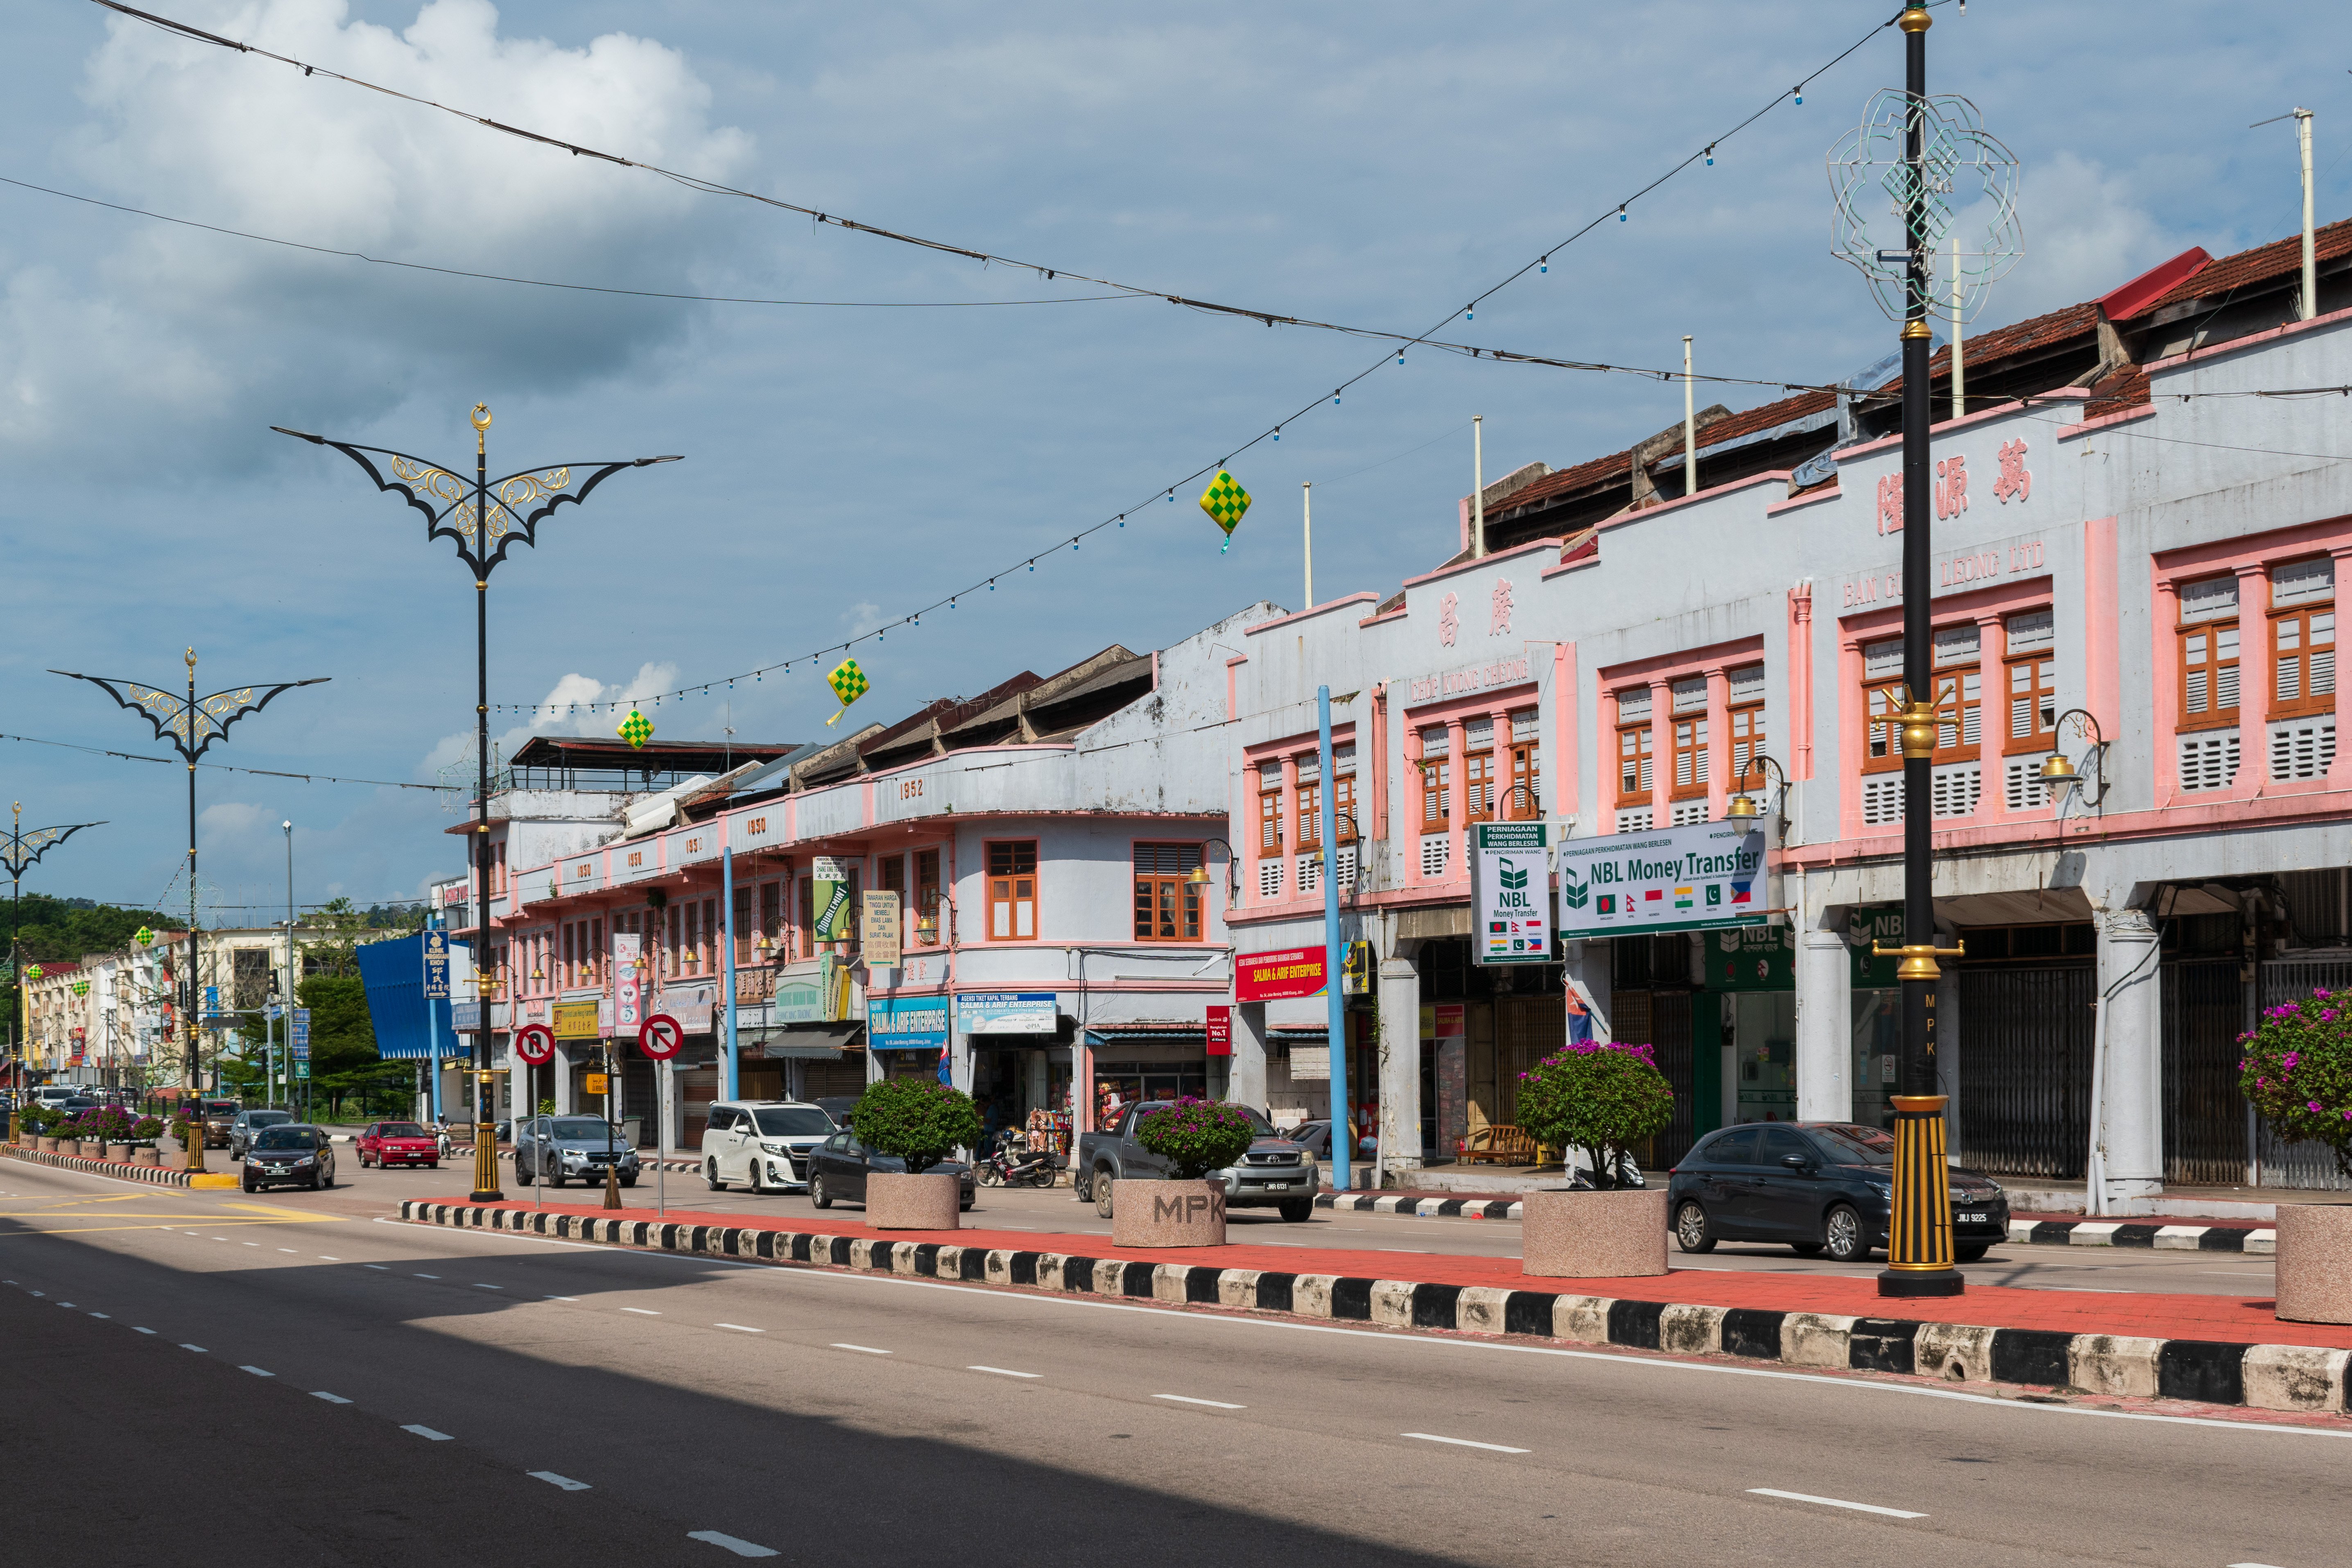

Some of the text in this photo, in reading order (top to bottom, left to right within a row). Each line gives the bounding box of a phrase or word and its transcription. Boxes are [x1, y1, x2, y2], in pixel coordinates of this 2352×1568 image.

[1843, 541, 2044, 608] BAN GU LEONG LTD
[1412, 657, 1528, 702] CHOP KWONG CHEONG
[900, 779, 923, 800] 1952
[748, 817, 766, 836] 1950
[686, 837, 703, 853] 1950
[1566, 848, 1594, 857] PERNIAGAAN
[1595, 844, 1632, 853] PERKHIDMATAN
[1648, 839, 1671, 848] BERLESEN
[628, 851, 642, 867] 1950
[1591, 846, 1759, 885] NBL Money Transfer
[578, 863, 590, 877] 1950
[1499, 892, 1531, 907] NBL
[817, 886, 847, 934] DOUBLEMINT
[1493, 908, 1538, 919] Money Transfer
[1743, 926, 1778, 942] NBL
[1875, 915, 1905, 936] NB
[1254, 963, 1321, 982] SALMA & ARIF ENTERPRISE
[776, 1010, 788, 1020] CHANG
[789, 1010, 797, 1020] XING
[797, 1009, 812, 1019] TRADING
[872, 1008, 945, 1035] SALMA & ARIF ENTERPRISE
[1926, 994, 1935, 1055] MPK
[906, 1052, 916, 1061] MINI
[1154, 1195, 1225, 1223] MPK
[1971, 1213, 1987, 1222] 9225
